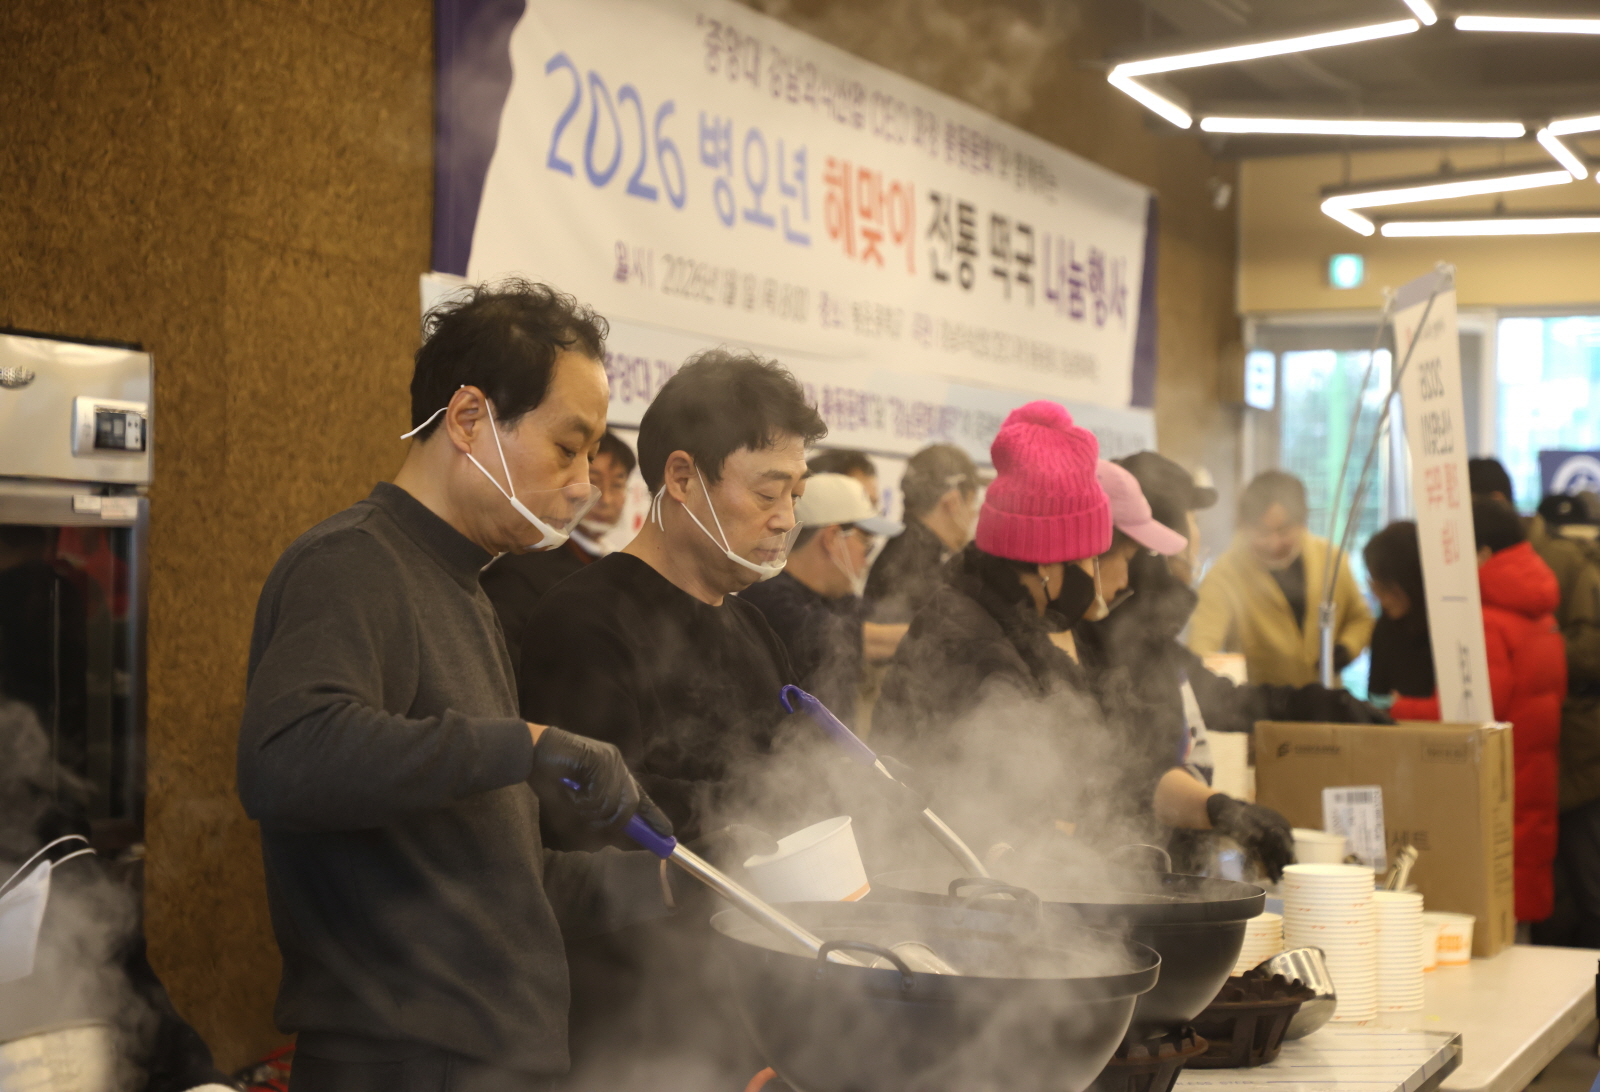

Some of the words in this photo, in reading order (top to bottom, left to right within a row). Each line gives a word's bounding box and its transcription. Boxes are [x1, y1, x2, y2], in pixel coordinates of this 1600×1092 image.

[545, 52, 687, 211] 2026
[698, 110, 812, 247] 병오년
[822, 154, 917, 277] 해맞이
[925, 189, 979, 291] 전통
[988, 210, 1036, 308] 떡국
[1042, 230, 1128, 333] 나눔행사
